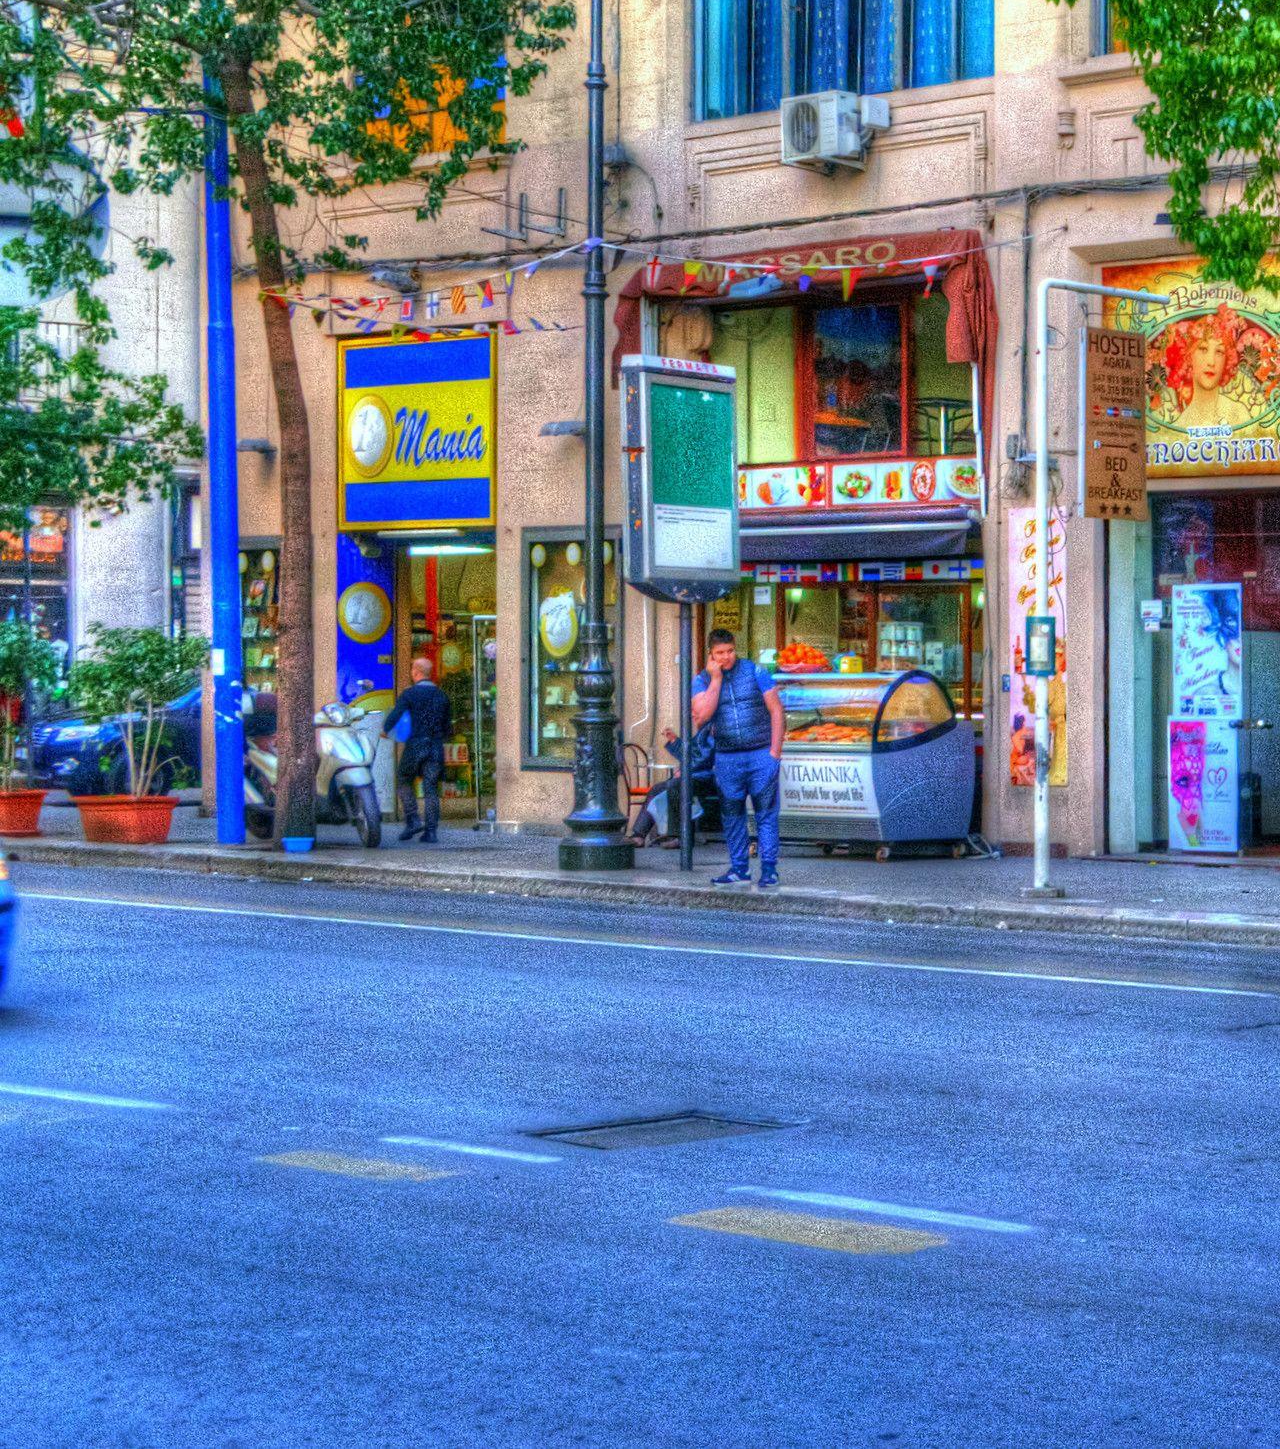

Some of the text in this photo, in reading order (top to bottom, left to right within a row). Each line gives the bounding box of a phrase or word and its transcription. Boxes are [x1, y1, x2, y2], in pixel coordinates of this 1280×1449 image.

[1089, 333, 1144, 358] HOSTEL
[1103, 357, 1131, 369] AGATA
[395, 407, 487, 467] Mania
[1105, 456, 1127, 471] BED
[1111, 473, 1120, 487] &
[1088, 487, 1142, 501] BREAKFAST
[781, 765, 861, 783] VITAMINIKA
[784, 789, 800, 801] easy
